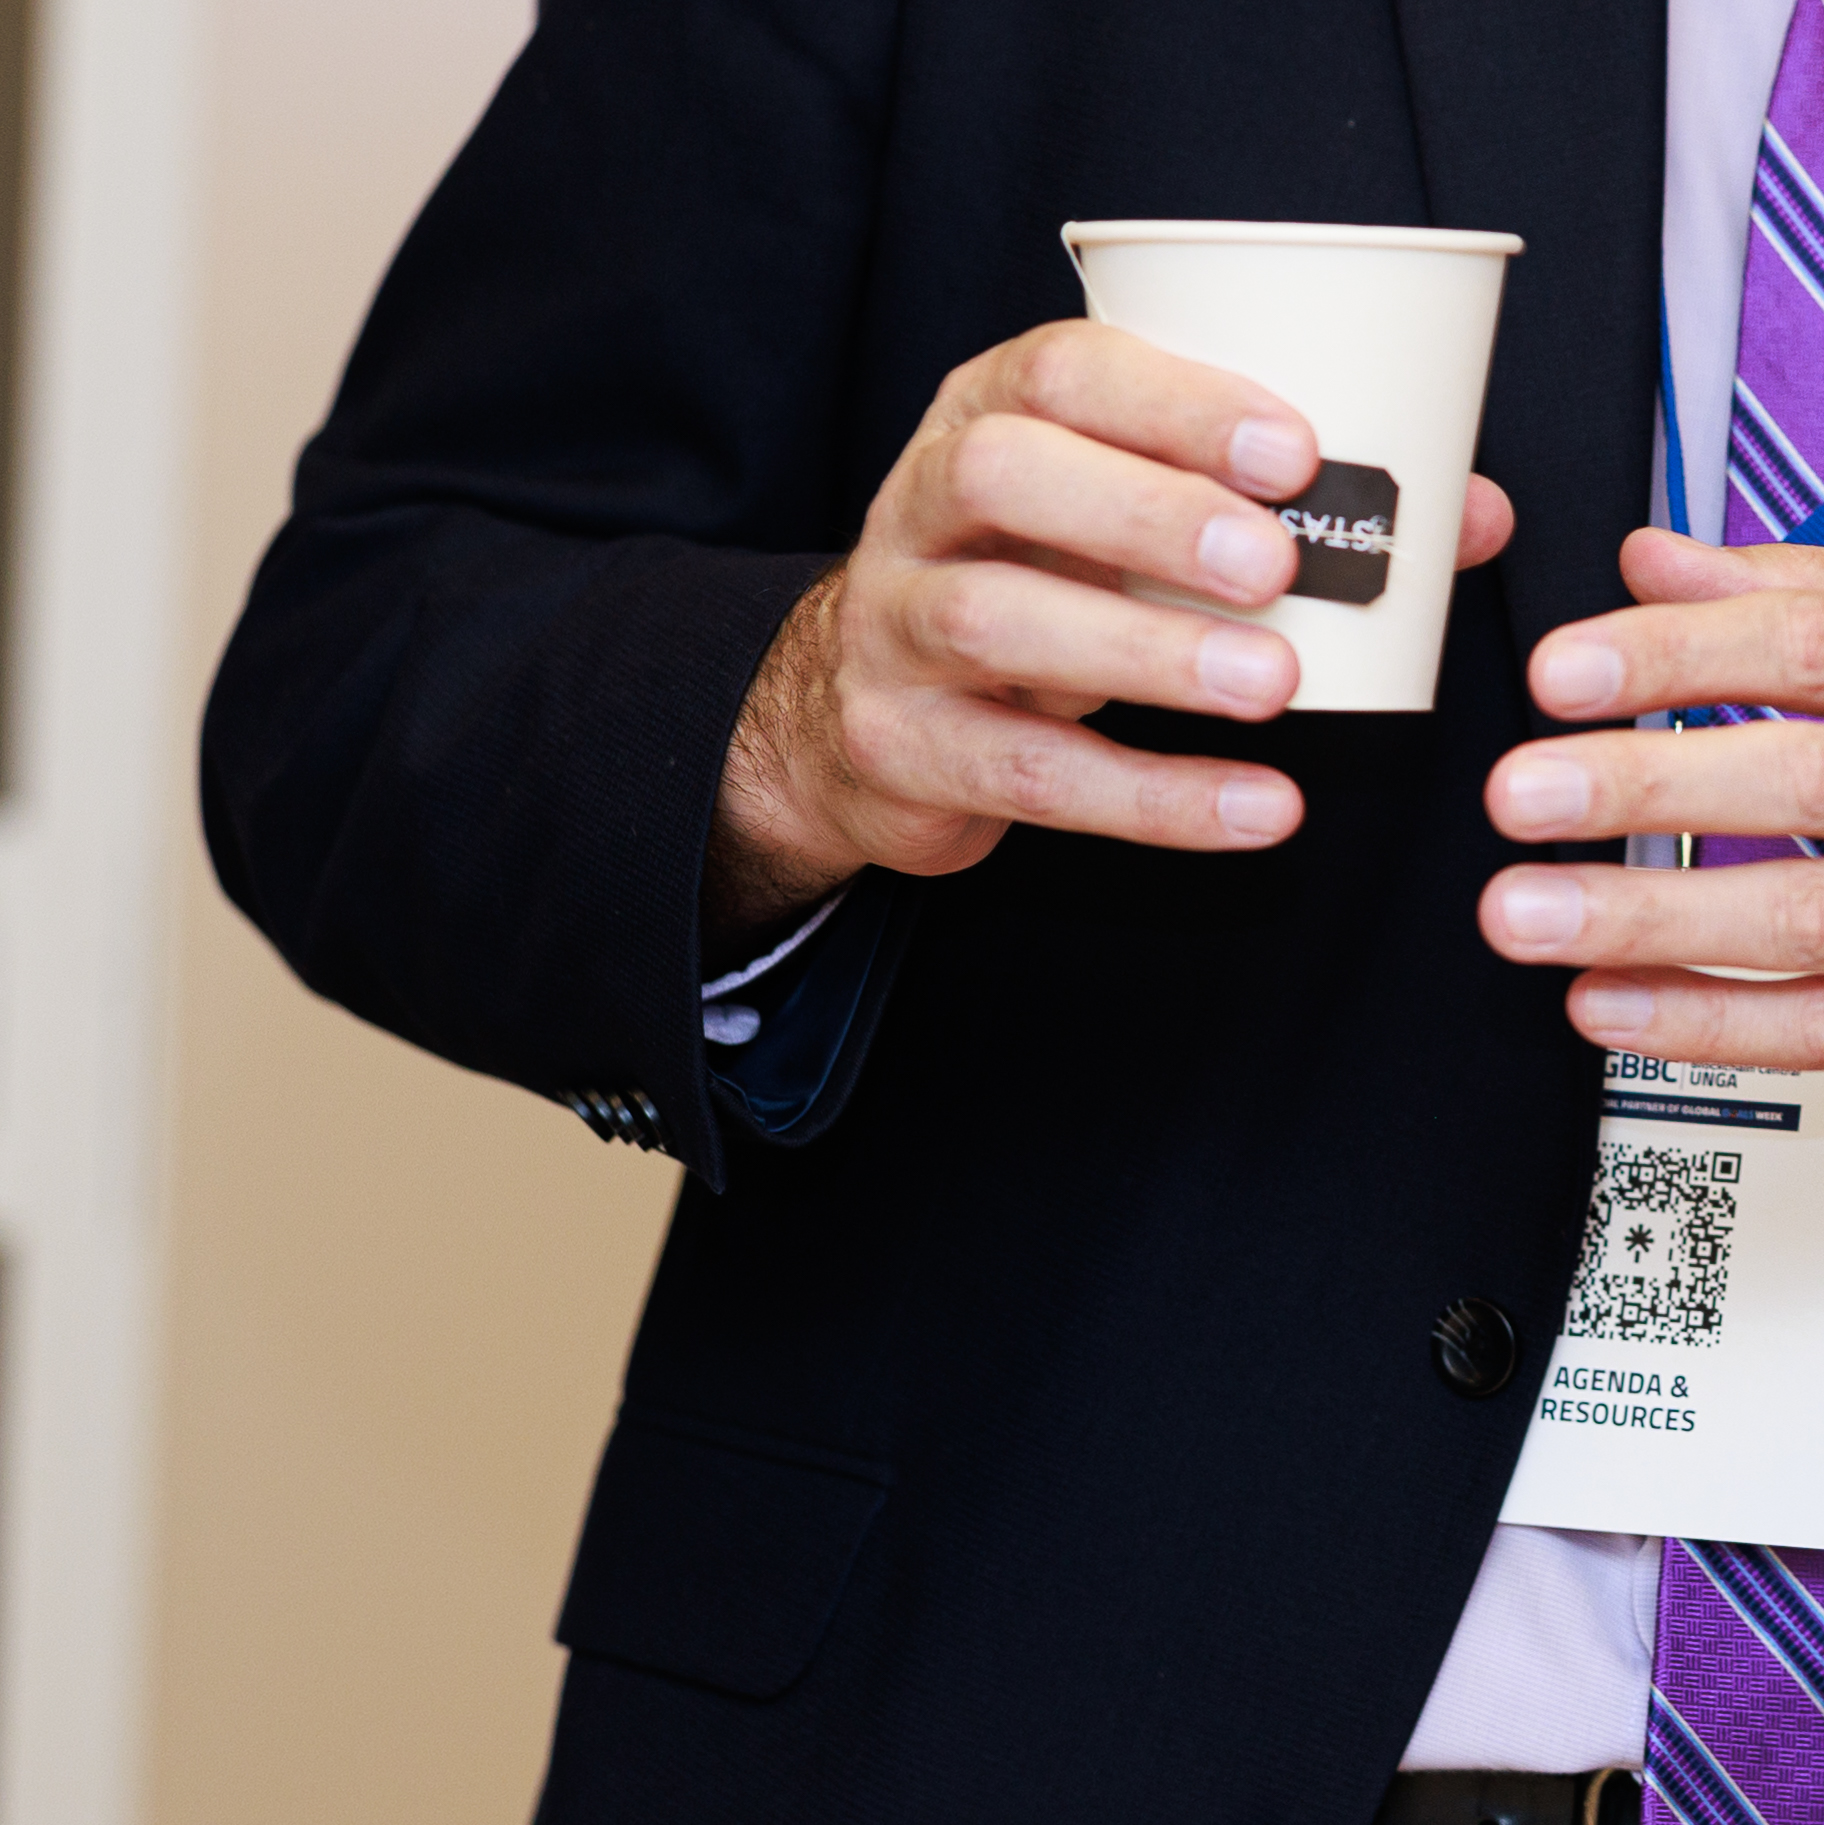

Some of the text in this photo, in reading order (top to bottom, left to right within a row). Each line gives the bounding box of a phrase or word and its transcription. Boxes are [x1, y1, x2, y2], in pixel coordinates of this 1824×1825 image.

[1273, 507, 1377, 553] STAS
[1604, 1050, 1677, 1083] GBBC
[1690, 1070, 1738, 1088] UNGA
[1681, 1104, 1721, 1116] GLOBAL
[1755, 1110, 1783, 1122] WEEK
[1554, 1366, 1689, 1398] AGENDA &
[1540, 1398, 1696, 1432] RESOURCES
